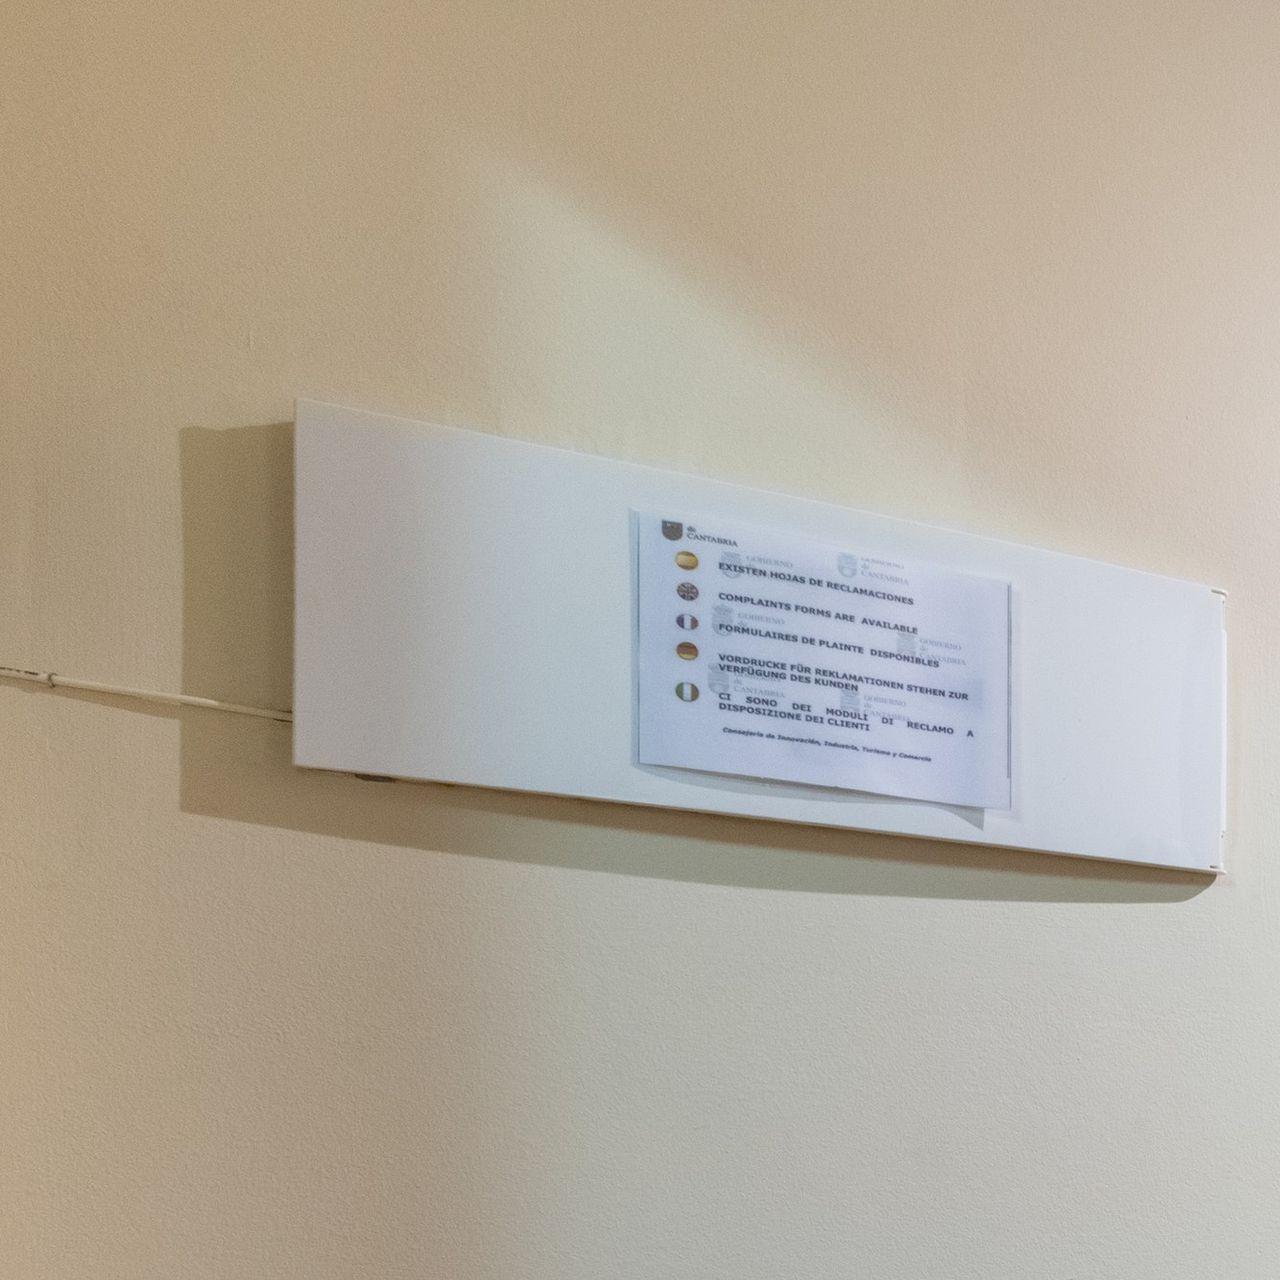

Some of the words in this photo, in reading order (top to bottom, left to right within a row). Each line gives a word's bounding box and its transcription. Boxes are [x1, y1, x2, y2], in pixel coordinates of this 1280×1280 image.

[686, 532, 739, 548] CANTABRIA
[718, 561, 767, 578] EXISTEN
[769, 571, 806, 584] HOJAS
[808, 578, 824, 588] DE
[826, 581, 915, 606] RECLAMACIONES
[718, 592, 792, 612] COMPLAINTS
[794, 605, 832, 619] FORMS
[834, 612, 856, 623] ARE
[861, 617, 919, 635] AVAILABLE
[718, 623, 798, 643] FORMULAIRES
[801, 636, 816, 646] DE
[819, 639, 864, 655] PLAINTE
[870, 648, 940, 668] DISPONIBLES
[718, 653, 788, 671] VORDRUCKE
[790, 662, 812, 675] FÜR
[815, 667, 904, 690] REKLAMATIONEN
[906, 684, 946, 698] STEHEN
[948, 690, 969, 701] ZUR
[718, 663, 787, 681] VERFÜGUNG
[790, 673, 812, 685] DES
[814, 677, 859, 693] KUNDEN
[718, 692, 731, 701] CI
[745, 695, 778, 708] SONO
[791, 702, 812, 713] DEI
[825, 707, 869, 722] MODULI
[881, 716, 894, 726] DI
[906, 720, 955, 736] RECLAMO
[966, 729, 975, 738] A
[718, 702, 802, 721] DISPOSIZIONE
[804, 714, 825, 725] DEI
[827, 717, 871, 732] CLIENTI
[765, 732, 776, 740] de
[862, 746, 892, 757] Turismo
[898, 751, 933, 762] Comercio
